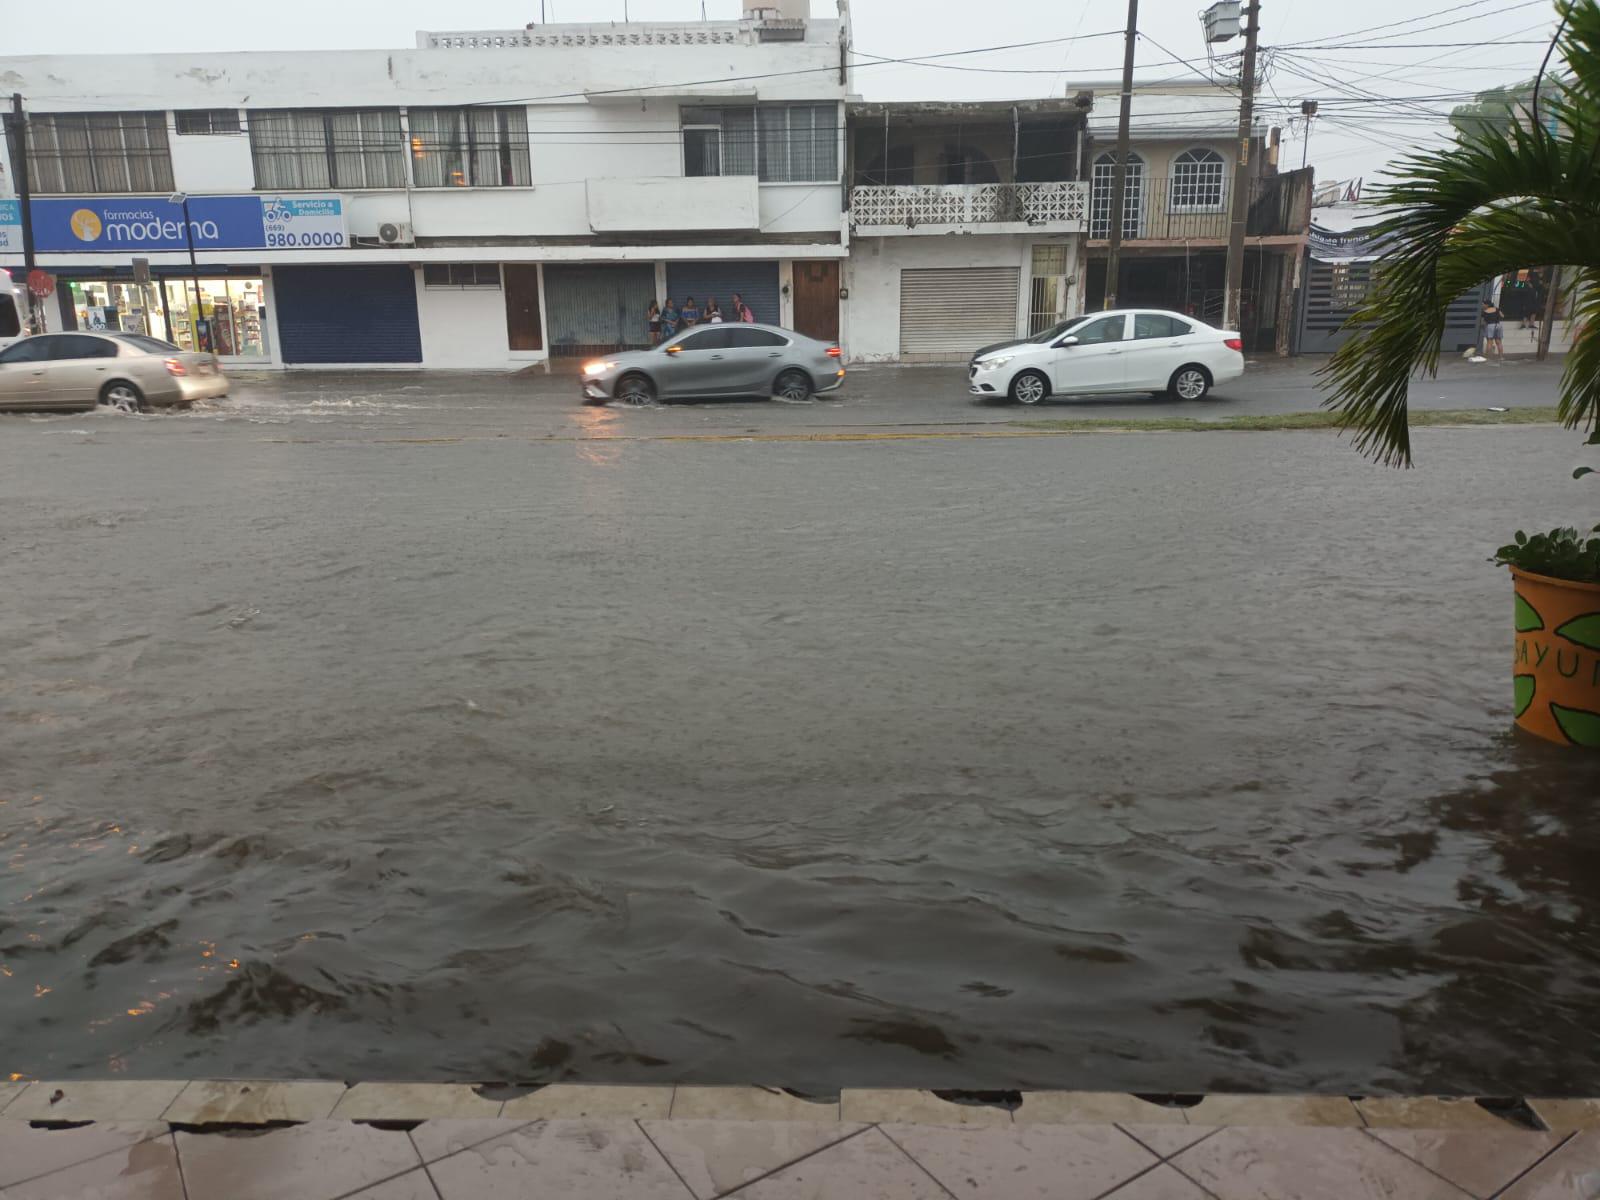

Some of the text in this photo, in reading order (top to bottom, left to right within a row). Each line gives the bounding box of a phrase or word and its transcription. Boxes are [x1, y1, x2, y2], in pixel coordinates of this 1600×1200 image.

[292, 200, 326, 208] Servicio
[104, 209, 154, 220] farmacias
[106, 217, 219, 241] moderna
[266, 224, 285, 232] (669)
[267, 232, 344, 247] 980.0000
